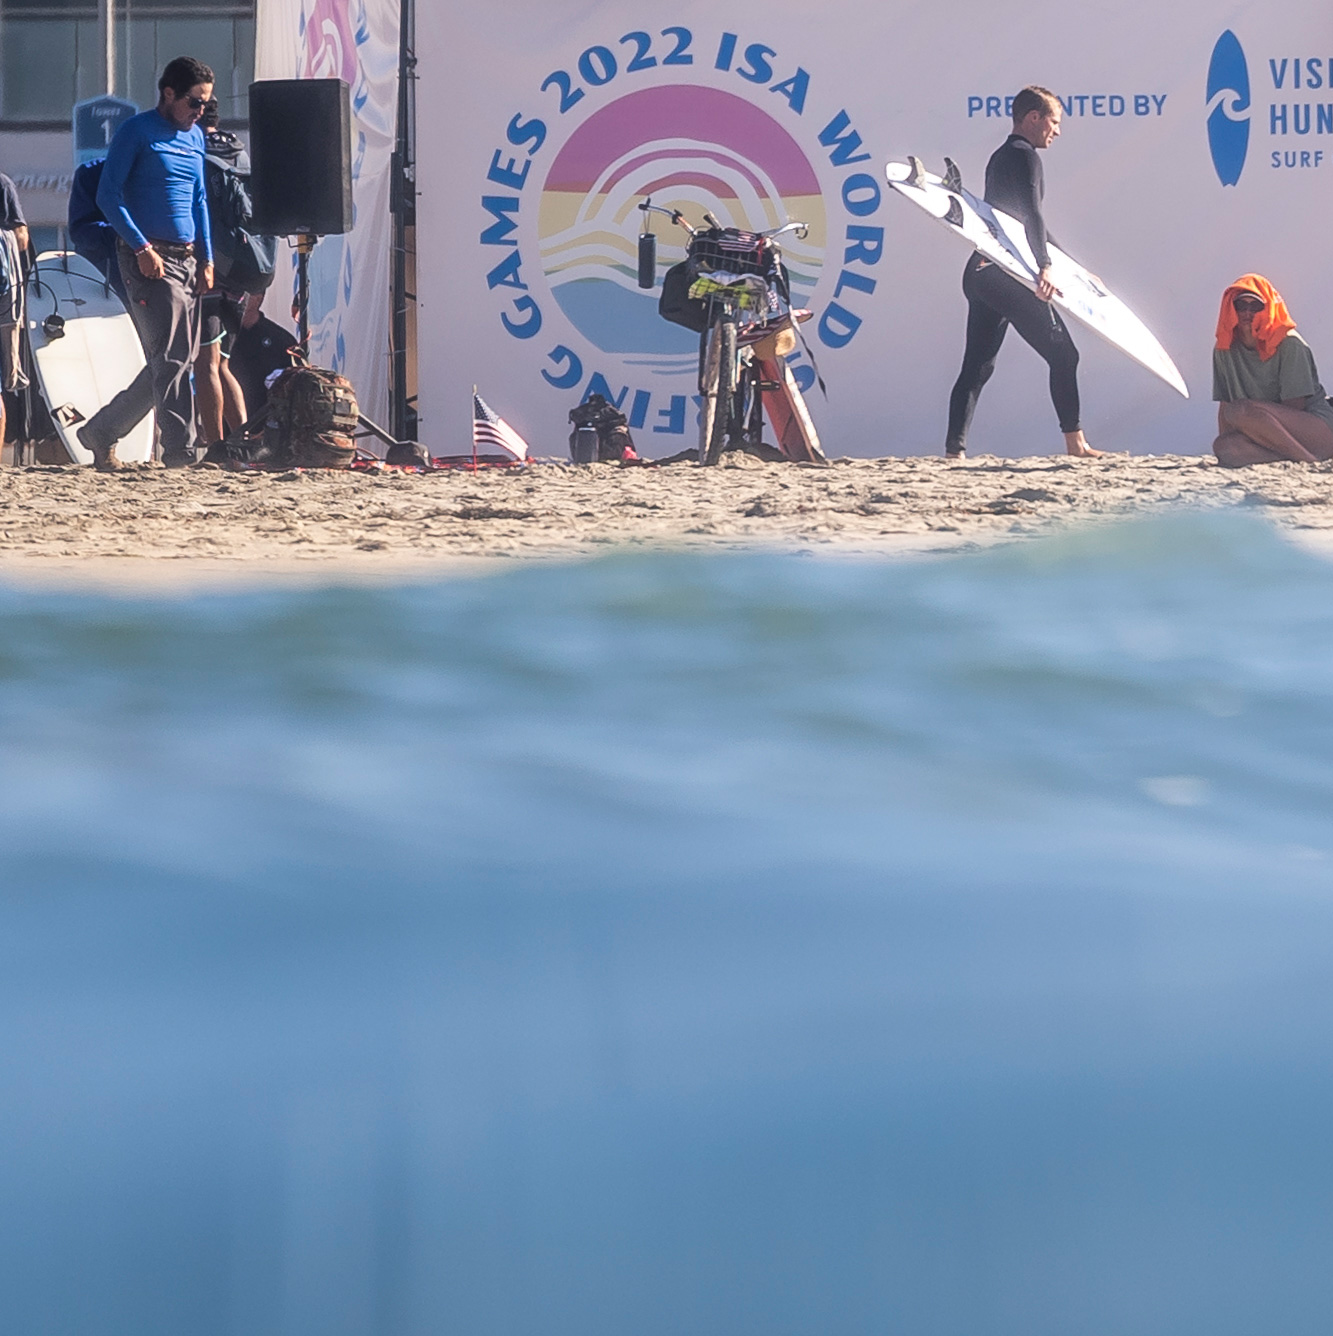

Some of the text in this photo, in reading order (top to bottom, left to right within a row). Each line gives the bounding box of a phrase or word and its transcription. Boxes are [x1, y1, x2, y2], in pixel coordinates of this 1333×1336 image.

[540, 26, 694, 114] 2022
[714, 32, 811, 116] ISA
[967, 94, 1168, 118] PRENTED BY
[1271, 149, 1325, 169] SURF
[480, 112, 547, 339] GAMES
[817, 109, 885, 350] WORLD
